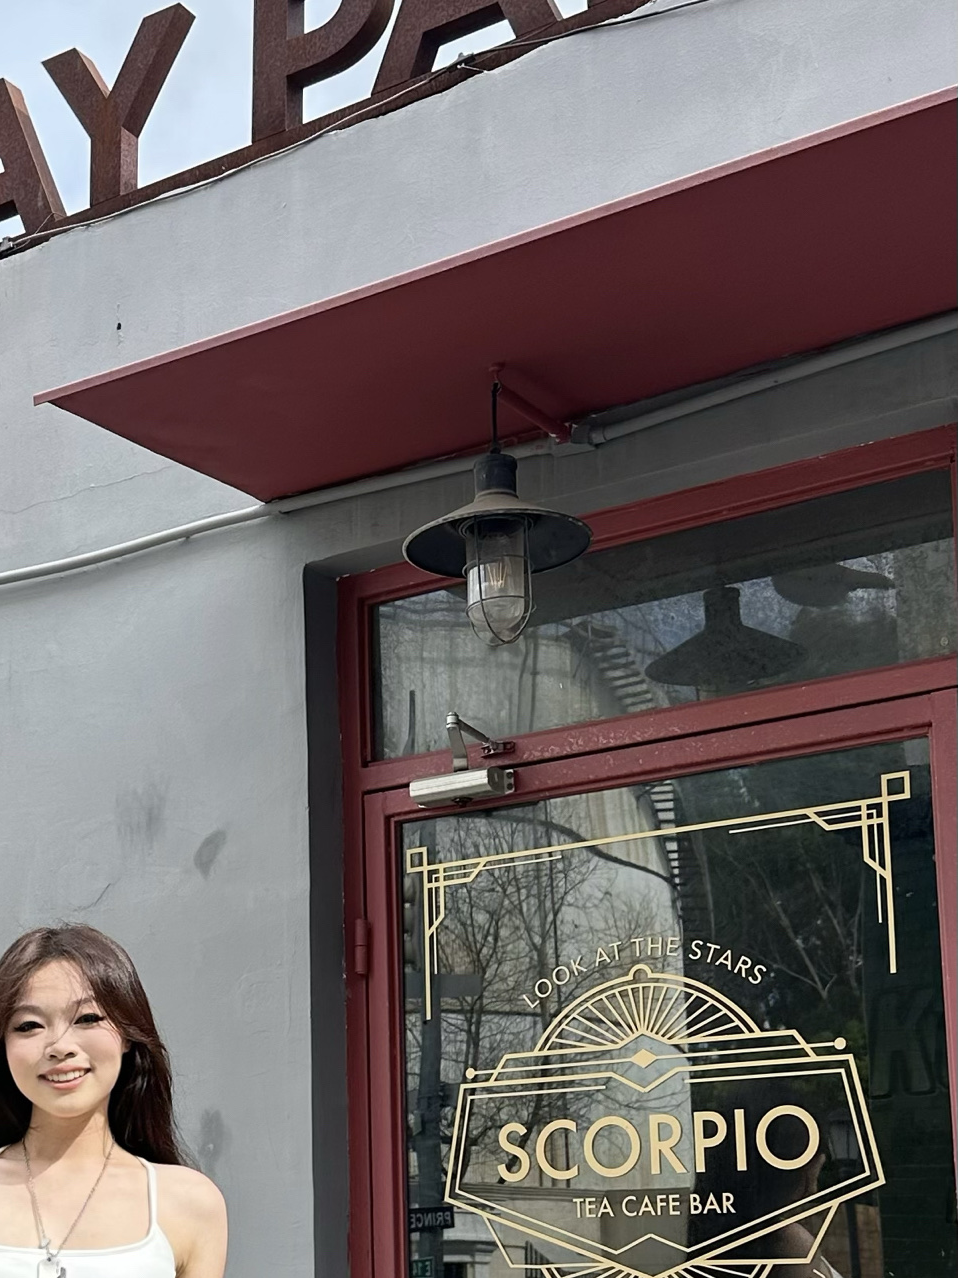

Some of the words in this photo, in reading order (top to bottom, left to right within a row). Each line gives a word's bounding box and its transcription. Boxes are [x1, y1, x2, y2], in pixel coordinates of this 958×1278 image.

[522, 955, 587, 1009] LOOK
[595, 941, 622, 967] AT
[630, 936, 681, 957] THE
[688, 939, 767, 985] STARS
[497, 1104, 820, 1183] SCORPIO
[572, 1196, 615, 1219] TEA
[621, 1193, 681, 1217] CAFE
[690, 1192, 736, 1214] BAR
